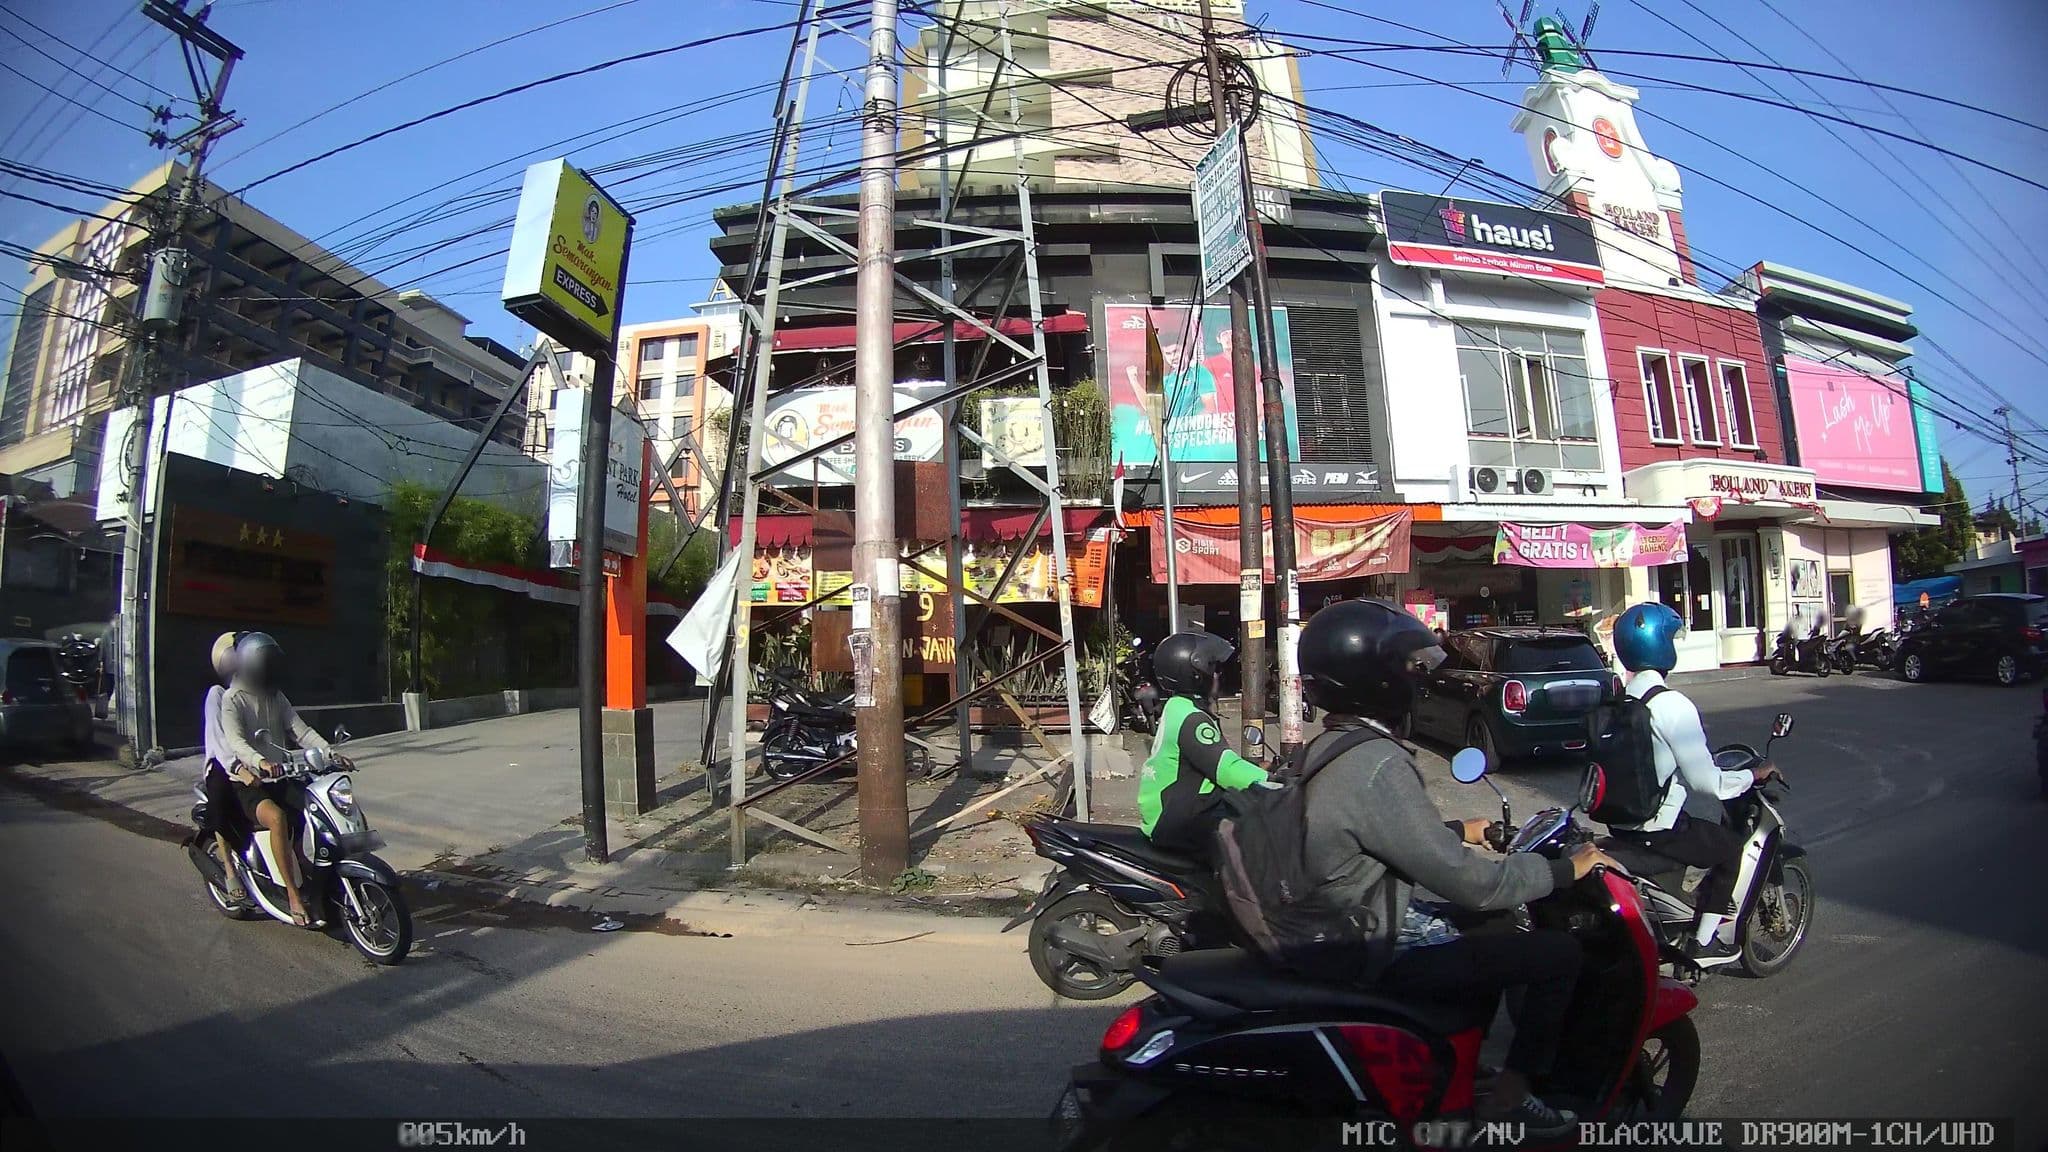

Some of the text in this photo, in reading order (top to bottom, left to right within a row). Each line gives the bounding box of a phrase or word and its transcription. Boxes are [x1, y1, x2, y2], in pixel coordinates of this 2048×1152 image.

[1471, 214, 1555, 252] haus!
[556, 269, 597, 308] EXPRESS
[1819, 384, 1855, 428] Lash
[619, 463, 639, 487] PARK
[1709, 474, 1812, 499] HOLLAND AKERY
[617, 484, 637, 503] Hotel
[1560, 525, 1569, 540] 1
[1192, 546, 1220, 556] SPORT
[1519, 541, 1588, 560] GRATIS 1
